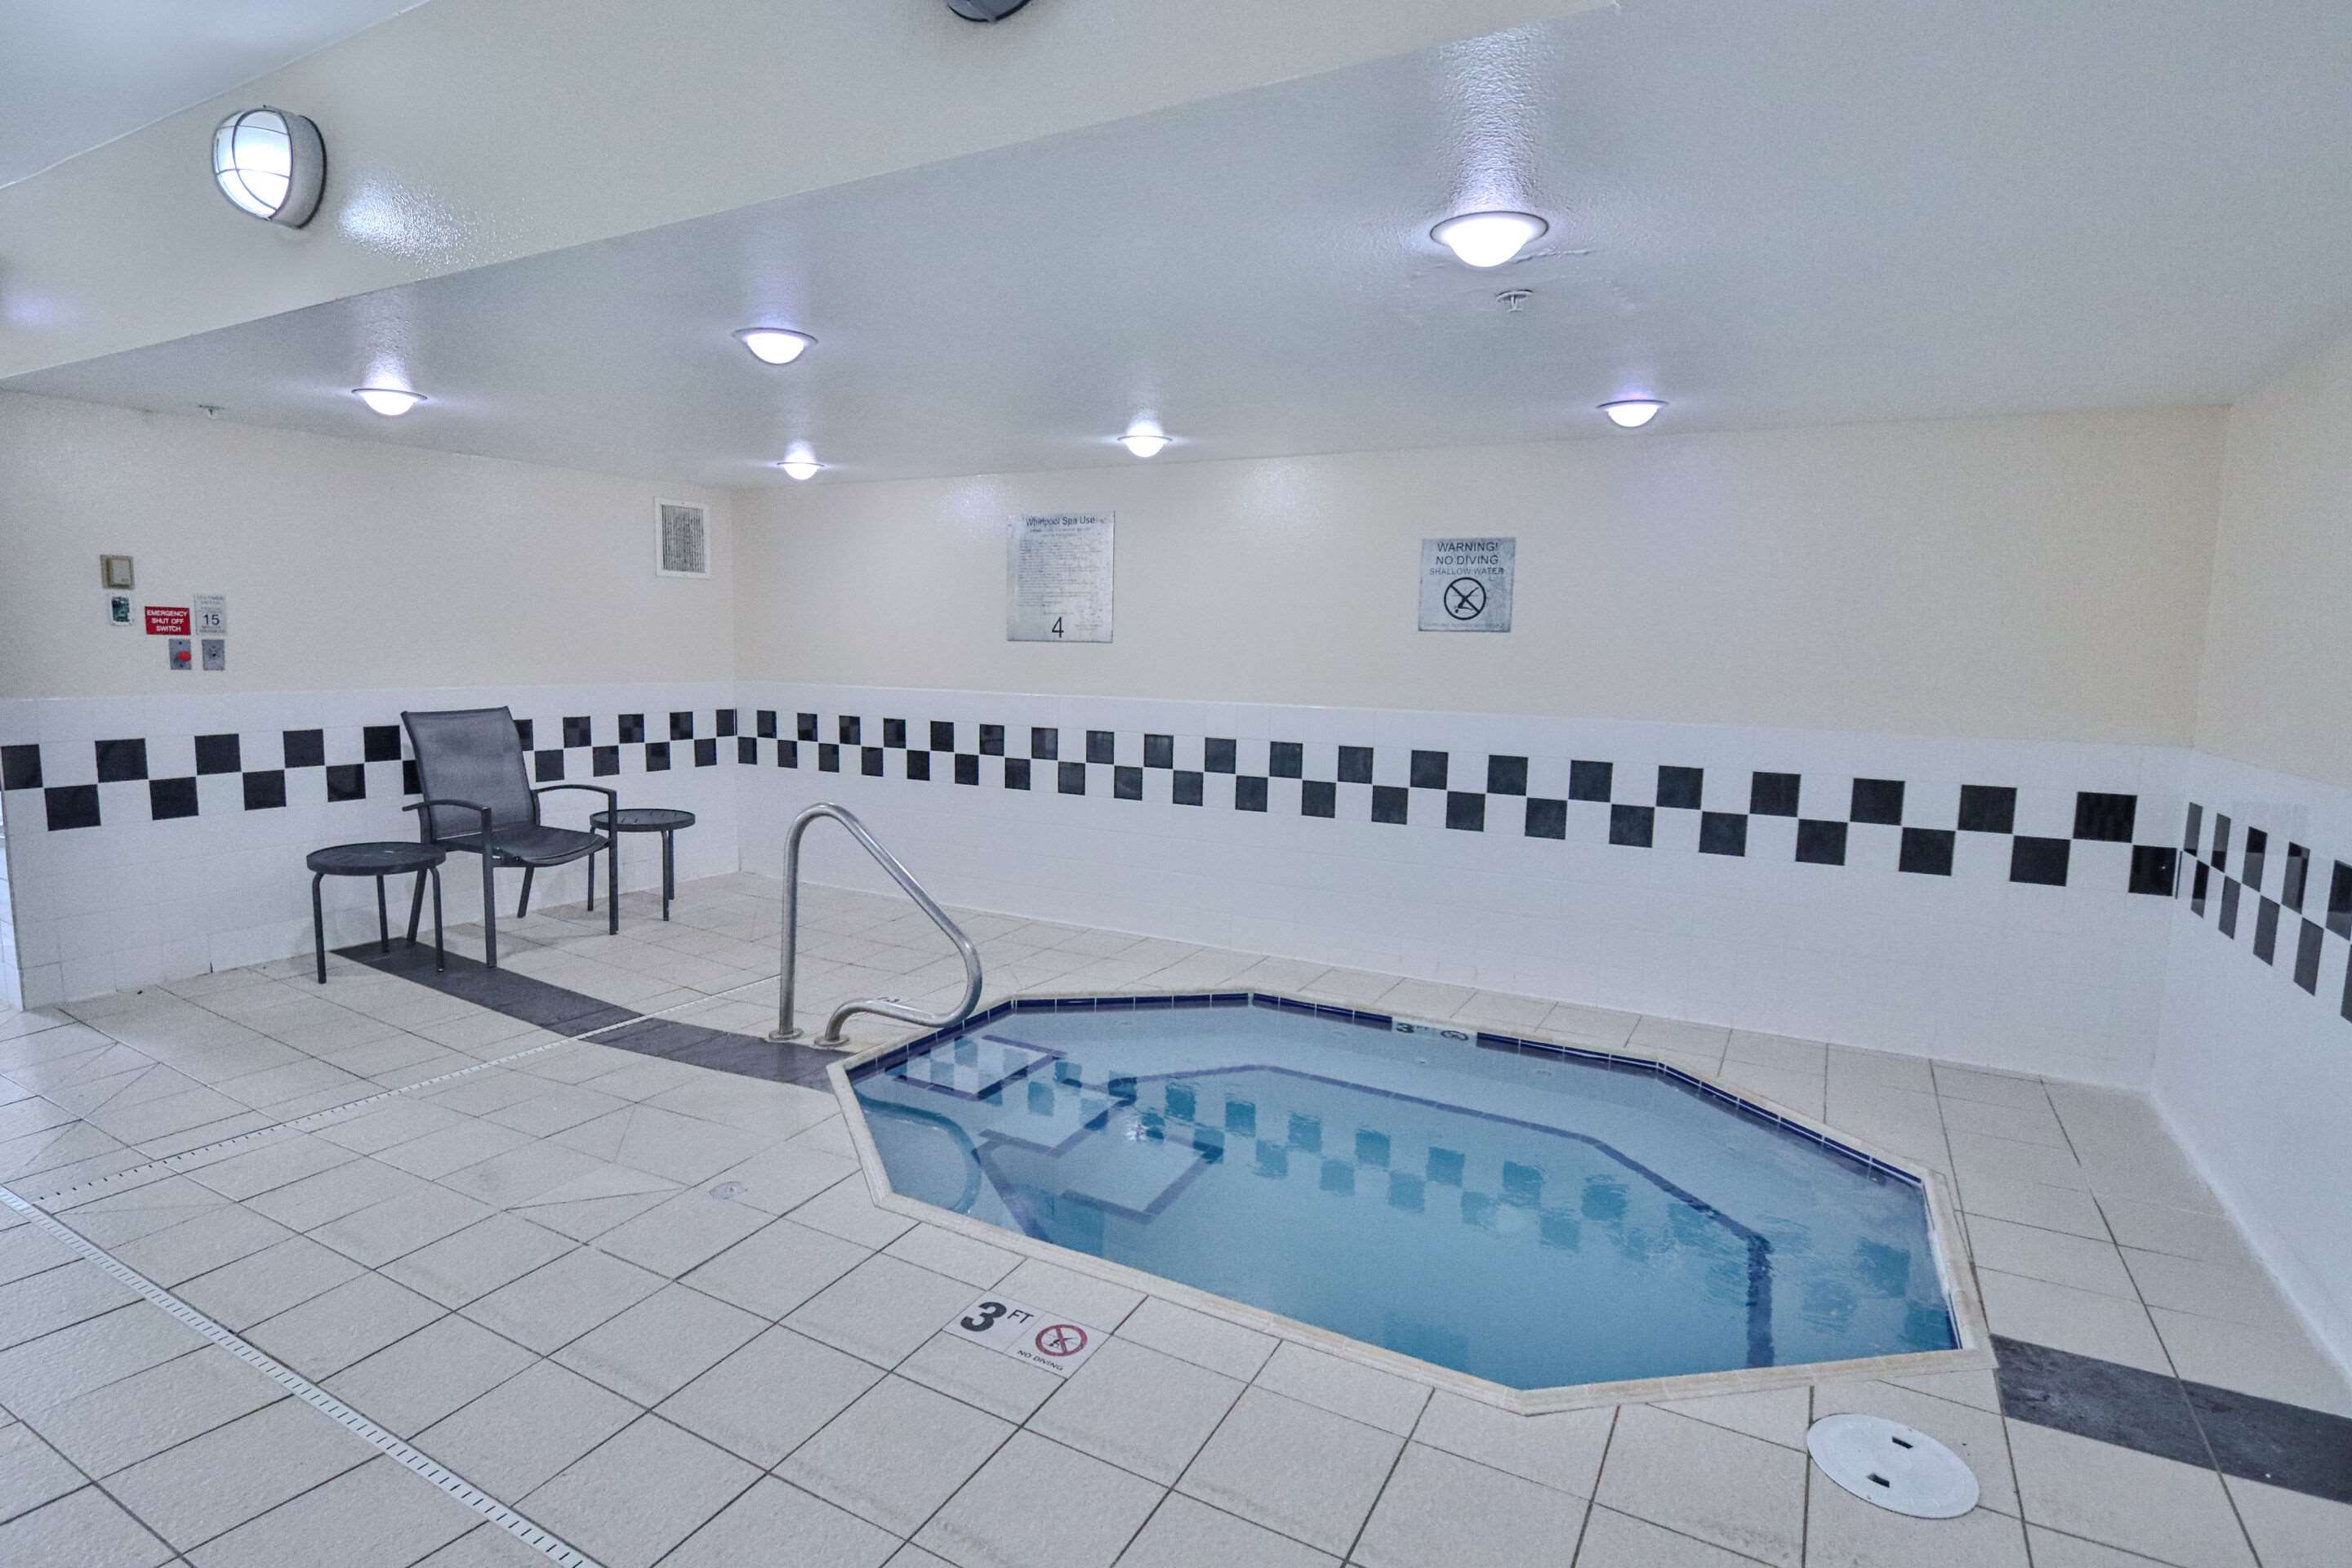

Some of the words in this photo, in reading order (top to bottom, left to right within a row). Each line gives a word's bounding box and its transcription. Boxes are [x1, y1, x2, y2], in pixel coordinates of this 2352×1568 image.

[1080, 516, 1096, 524] Use
[1437, 541, 1499, 552] WARNING!
[1436, 555, 1454, 565] NO
[1457, 555, 1499, 565] DIVING
[1474, 567, 1504, 575] WATER
[203, 614, 220, 626] 15
[1051, 617, 1064, 638] 4
[960, 1301, 1007, 1332] 3
[1007, 1309, 1035, 1324] FT
[1017, 1349, 1031, 1359] NO
[1032, 1355, 1063, 1371] DIVING
